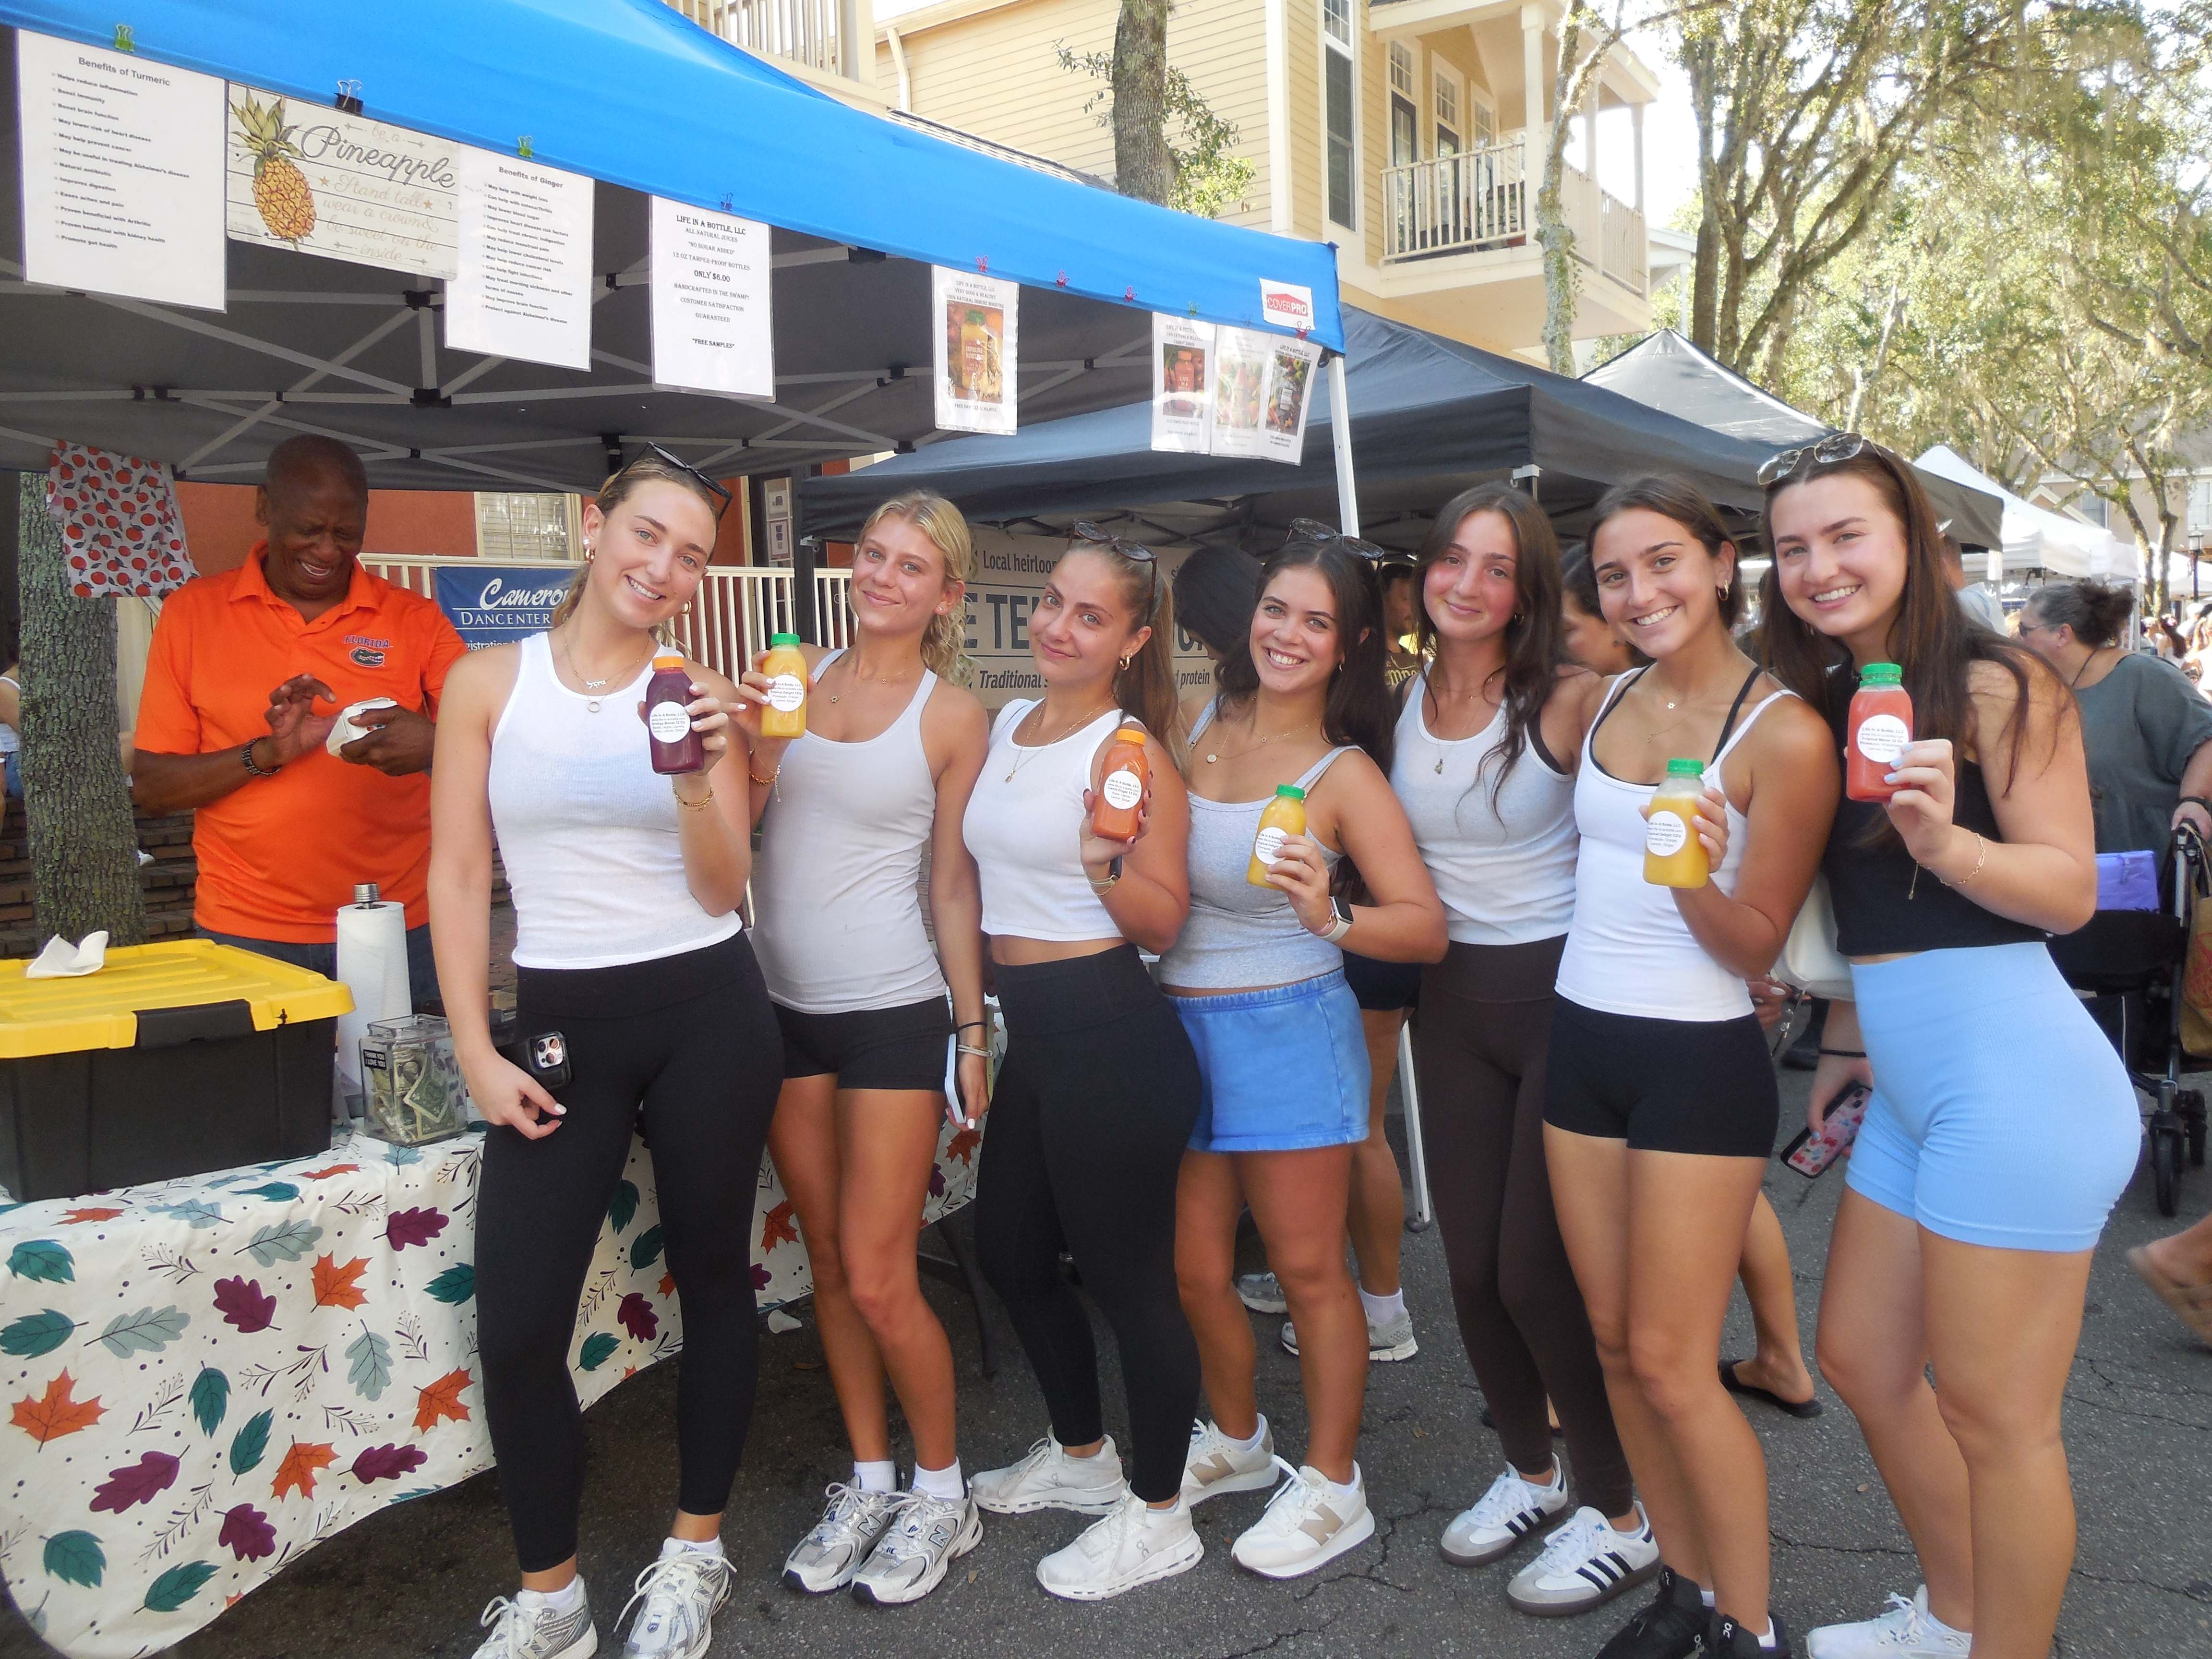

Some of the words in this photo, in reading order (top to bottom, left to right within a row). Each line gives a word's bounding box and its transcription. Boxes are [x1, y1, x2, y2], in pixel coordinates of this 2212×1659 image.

[78, 57, 116, 72] Benefits
[131, 70, 169, 85] Turmeric
[99, 84, 138, 95] inflammation
[77, 93, 105, 103] immunity
[94, 112, 119, 120] function
[301, 125, 455, 189] Pineapple
[109, 159, 132, 167] treating
[133, 163, 166, 173] Alzheimer's
[59, 177, 87, 185] Improves
[499, 167, 528, 179] Benefits
[540, 177, 563, 187] Ginger
[334, 174, 390, 200] Stand
[395, 190, 422, 208] tall
[82, 210, 111, 219] beneficial
[323, 198, 358, 214] wear
[364, 208, 373, 218] a
[676, 215, 690, 223] LIFE
[707, 222, 732, 232] BOTTLE,
[327, 214, 342, 233] be
[348, 227, 387, 241] sweet
[392, 234, 411, 246] on
[415, 234, 438, 252] the
[696, 230, 719, 238] NATURAL
[360, 244, 402, 262] inside
[689, 255, 727, 266] TAMPER-PROOF
[694, 270, 711, 278] ONLY
[712, 273, 730, 282] $6.00
[674, 283, 711, 294] HANDCRAFTED
[680, 297, 707, 305] CUSTOMER
[708, 302, 744, 311] SATISFACTION
[1267, 297, 1307, 314] COVERPRO
[695, 313, 730, 322] GUARANTEED
[983, 551, 1011, 570] Local
[1014, 553, 1056, 574] heirloo
[343, 635, 390, 648] FLORIDA
[979, 670, 1042, 690] Traditional
[1180, 669, 1210, 687] protein
